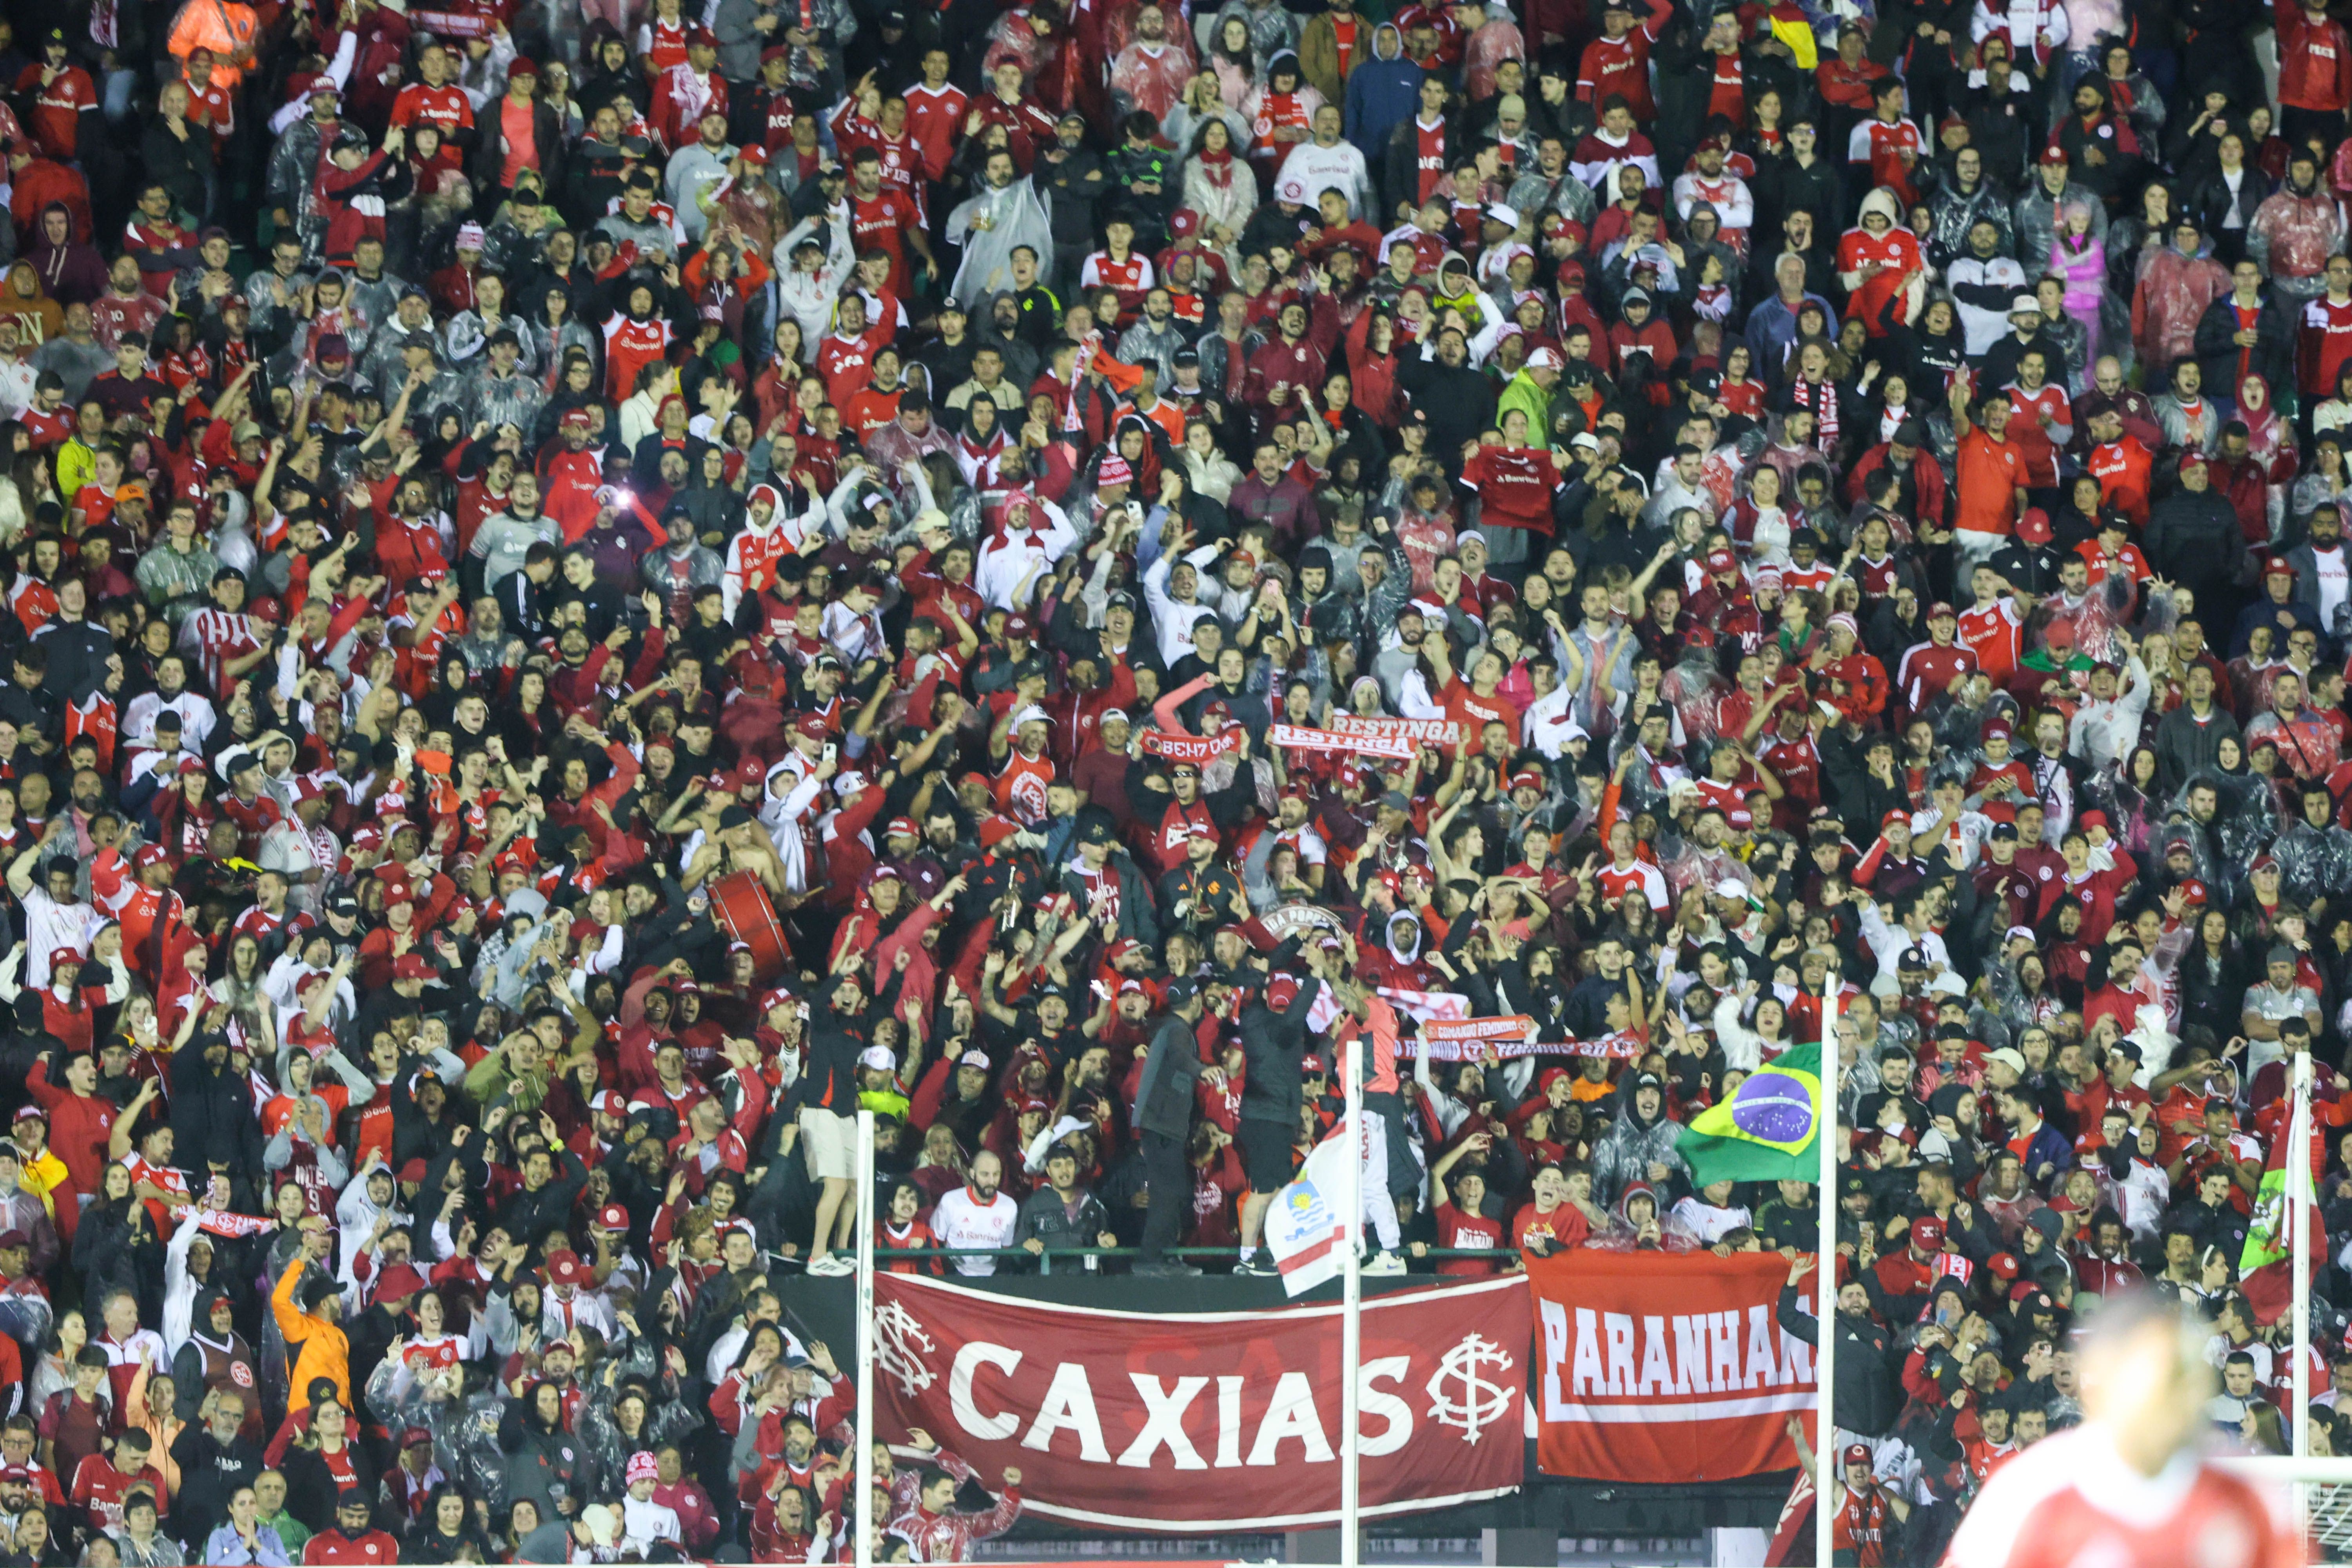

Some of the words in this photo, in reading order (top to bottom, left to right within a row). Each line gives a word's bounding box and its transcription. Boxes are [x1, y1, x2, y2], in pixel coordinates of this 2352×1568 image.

[1308, 164, 1349, 175] Banrisul
[14, 312, 44, 345] N
[1504, 472, 1540, 485] Banrisul
[1274, 724, 1411, 753] RESTINGA
[1333, 716, 1460, 741] RESTINGA
[1540, 1294, 1818, 1396] PARANHAN
[948, 1341, 1414, 1471] CAXIAS
